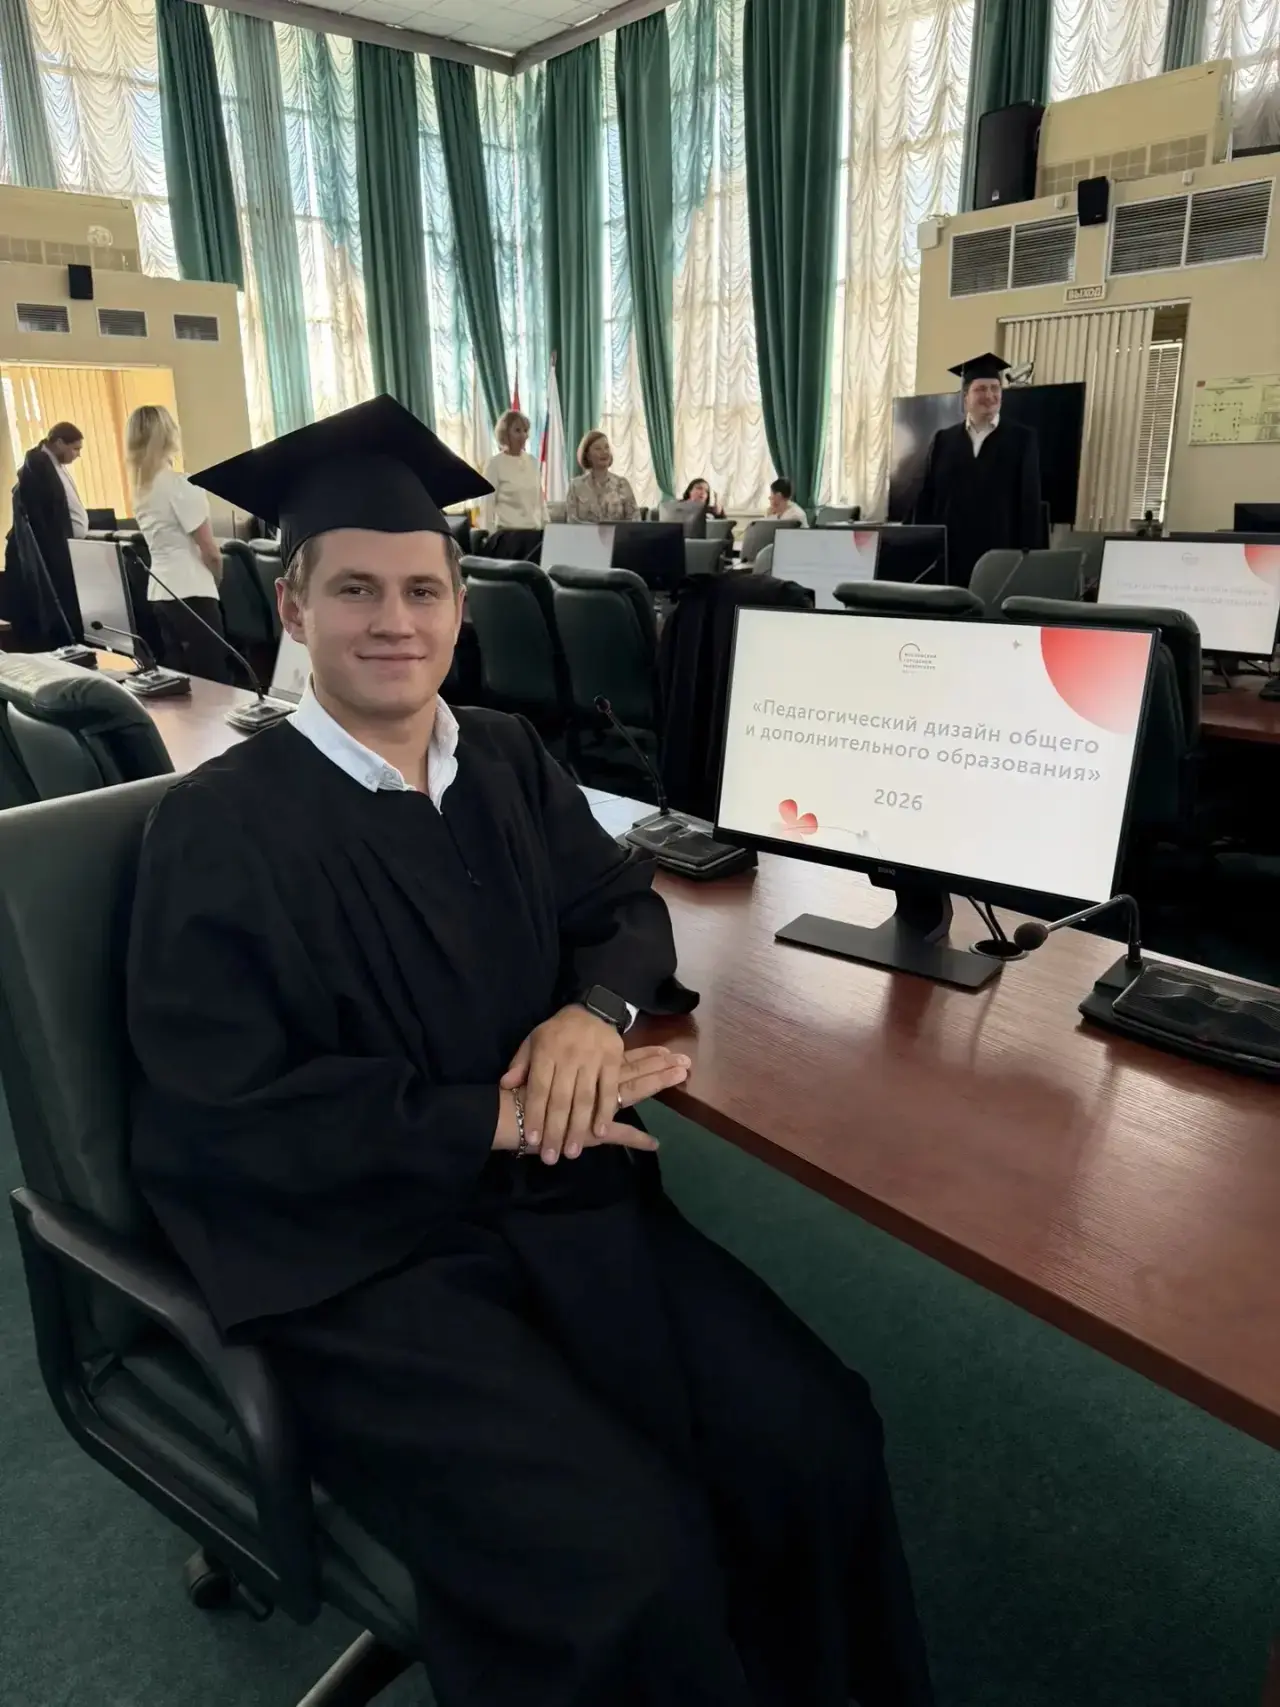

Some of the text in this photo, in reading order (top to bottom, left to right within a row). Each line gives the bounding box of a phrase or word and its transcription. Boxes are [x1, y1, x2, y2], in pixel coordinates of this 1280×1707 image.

[1068, 287, 1101, 300] ВЫХОД
[752, 698, 1100, 754] «Педагогический дизайн общего
[745, 724, 1101, 782] и дополнительного образования»
[873, 788, 923, 812] 2026
